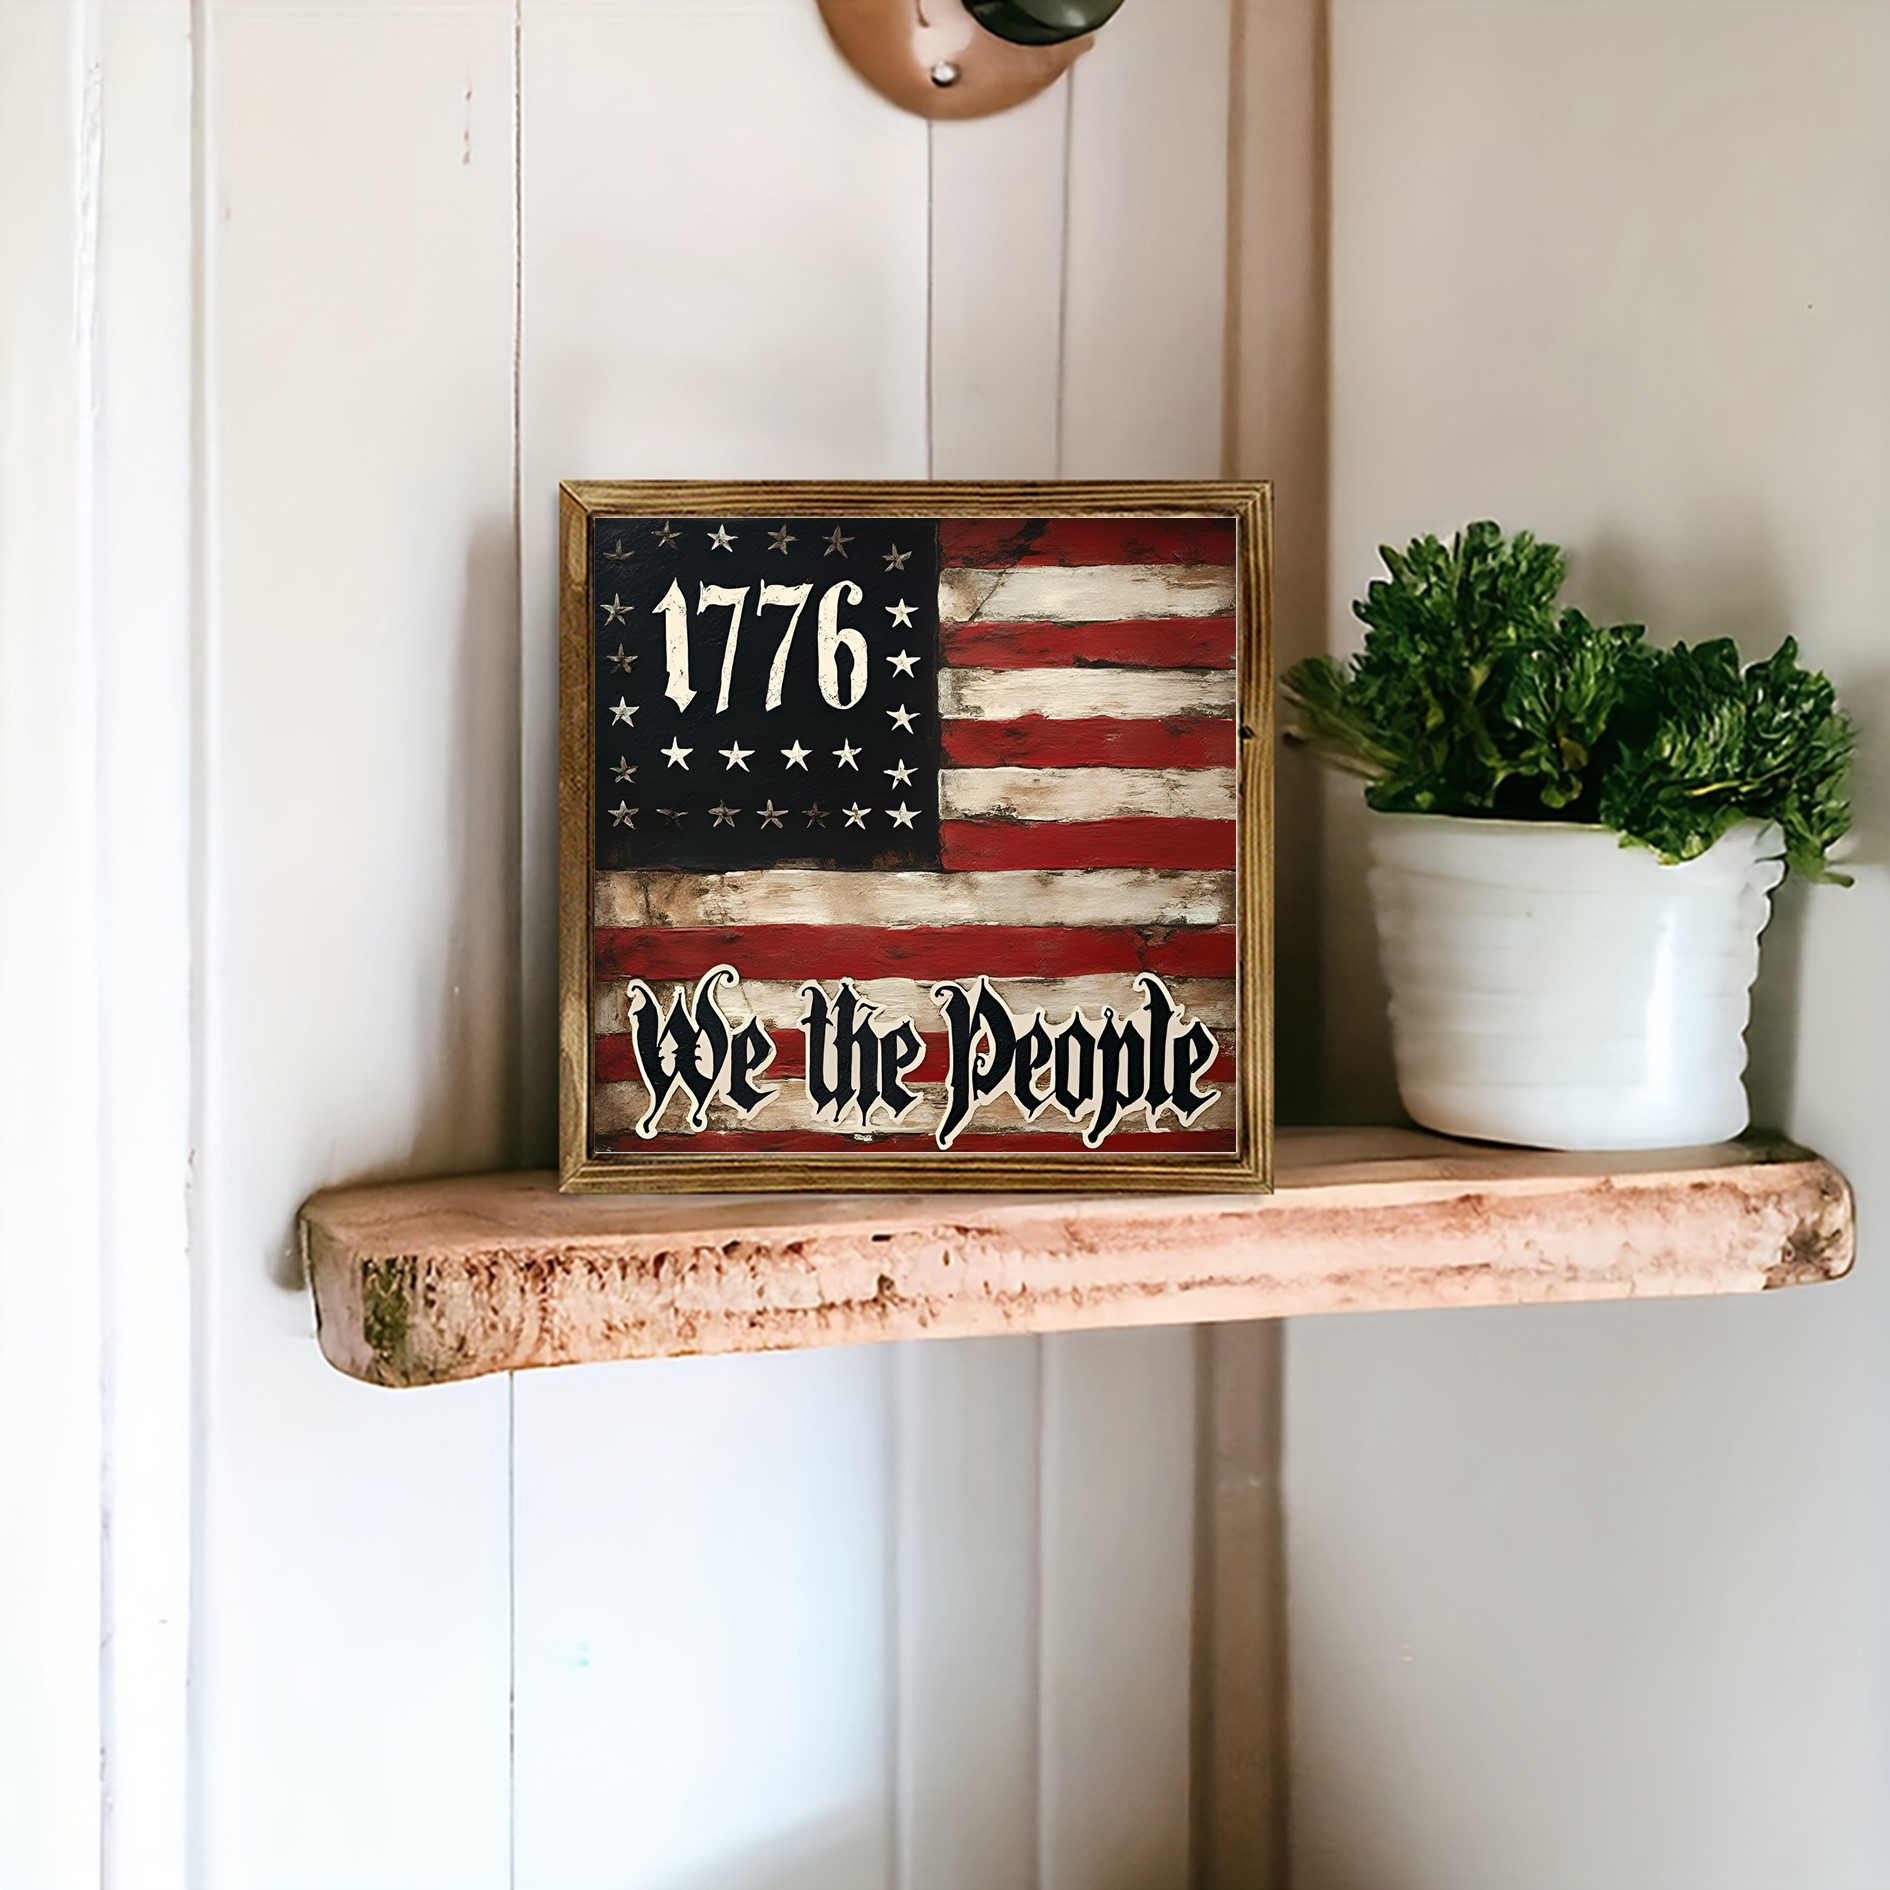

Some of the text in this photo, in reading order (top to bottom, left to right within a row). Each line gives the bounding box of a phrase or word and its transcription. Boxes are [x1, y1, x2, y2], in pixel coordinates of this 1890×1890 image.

[651, 577, 868, 715] 1776
[628, 966, 1221, 1148] We the People
